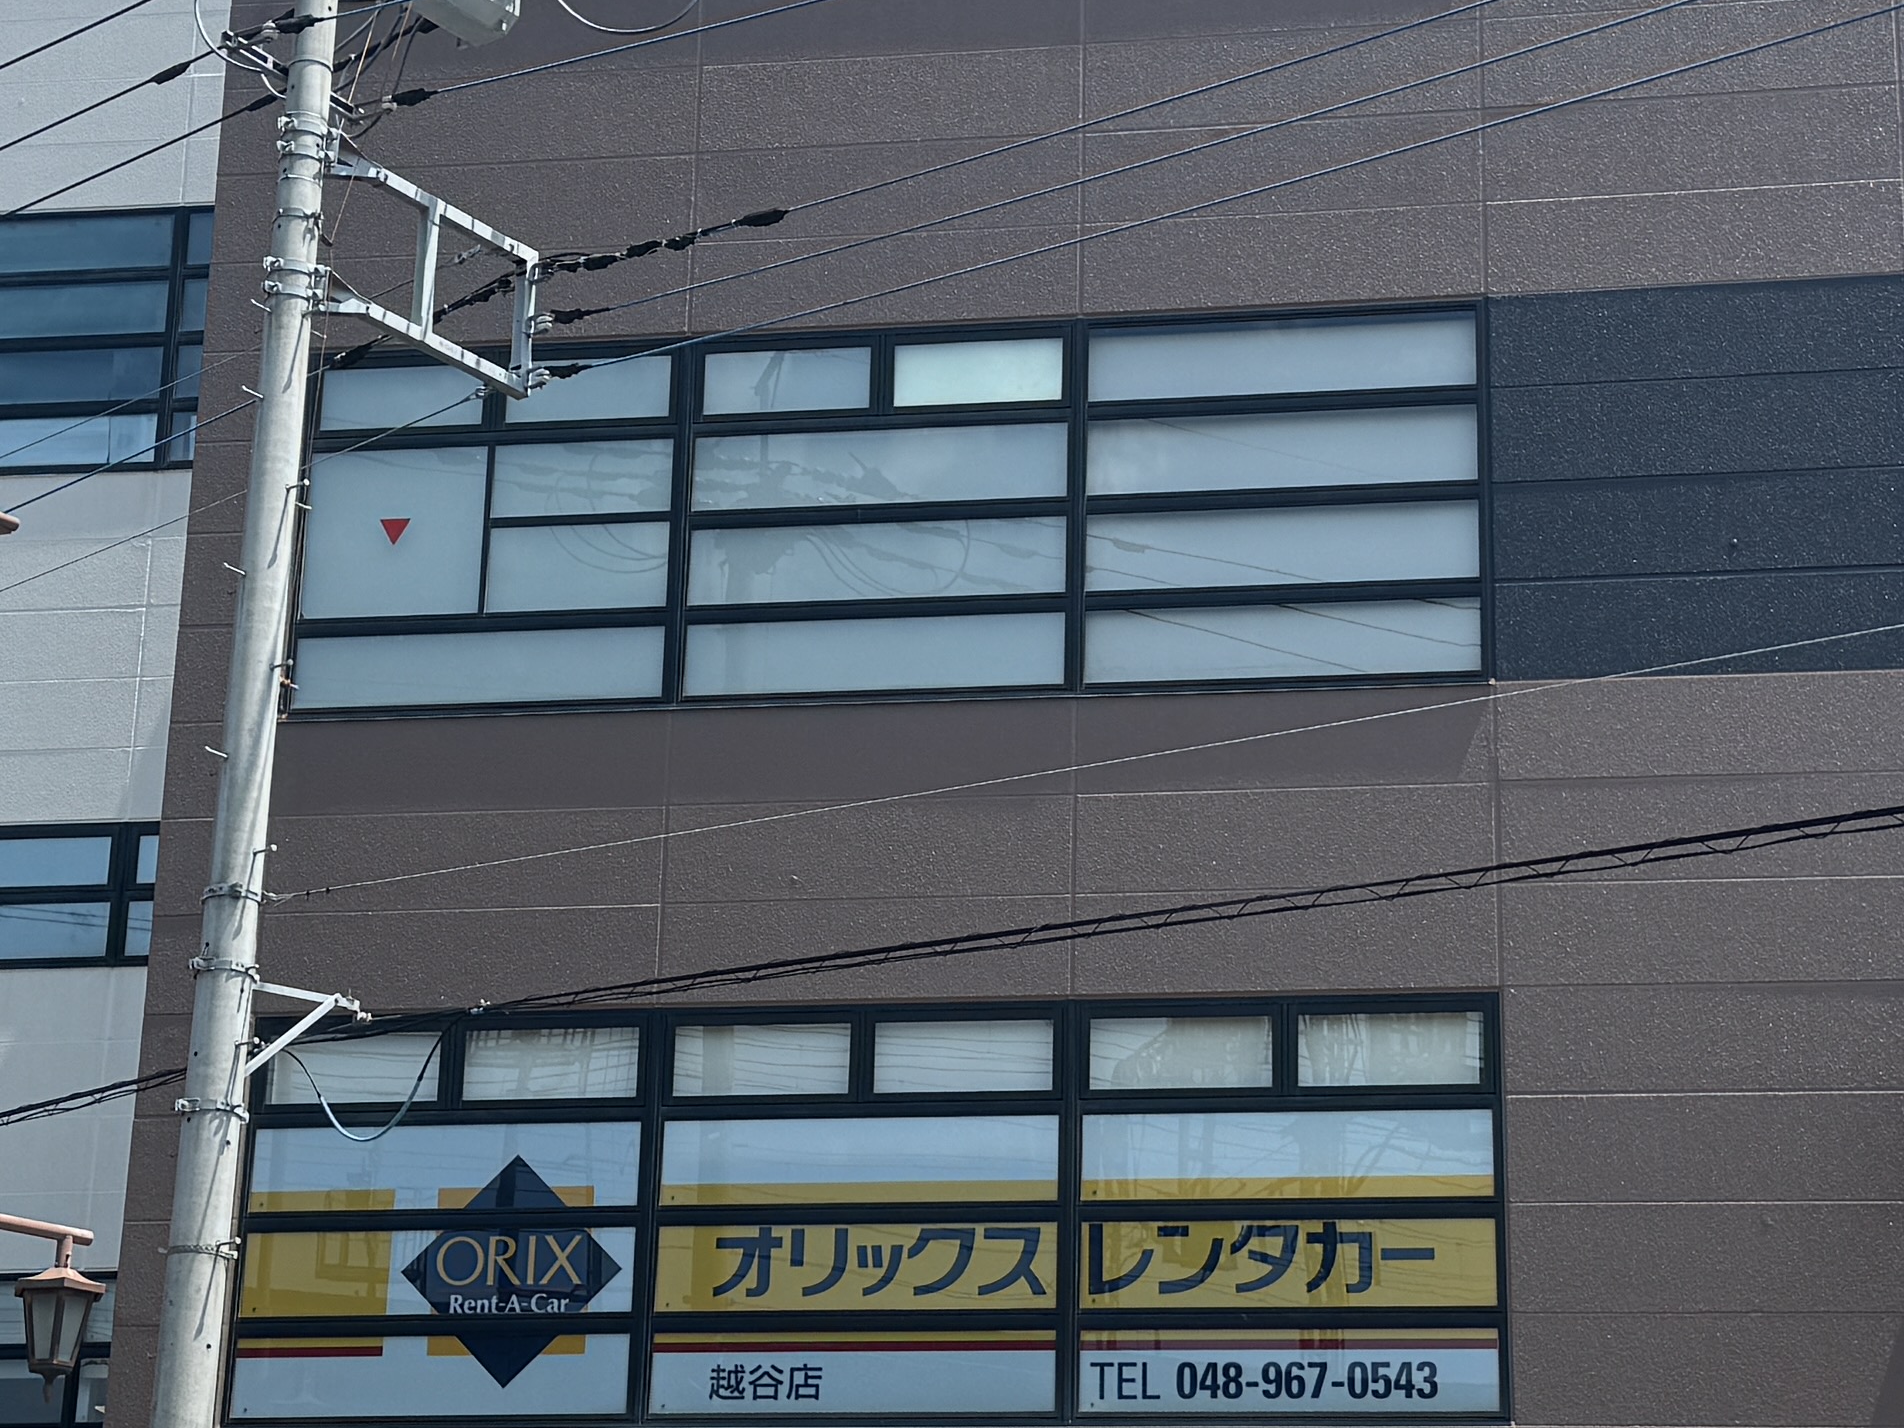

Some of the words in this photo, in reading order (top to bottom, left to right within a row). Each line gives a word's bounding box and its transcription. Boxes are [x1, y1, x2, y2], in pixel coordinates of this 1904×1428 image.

[436, 1233, 584, 1287] ORIX
[710, 1220, 1049, 1300] オリックス
[1085, 1217, 1437, 1295] レンタカー
[448, 1293, 571, 1314] Rent-A-Car
[707, 1362, 824, 1402] 越谷店
[1092, 1362, 1162, 1401] TEL
[1174, 1359, 1440, 1401] 048-967-0543
